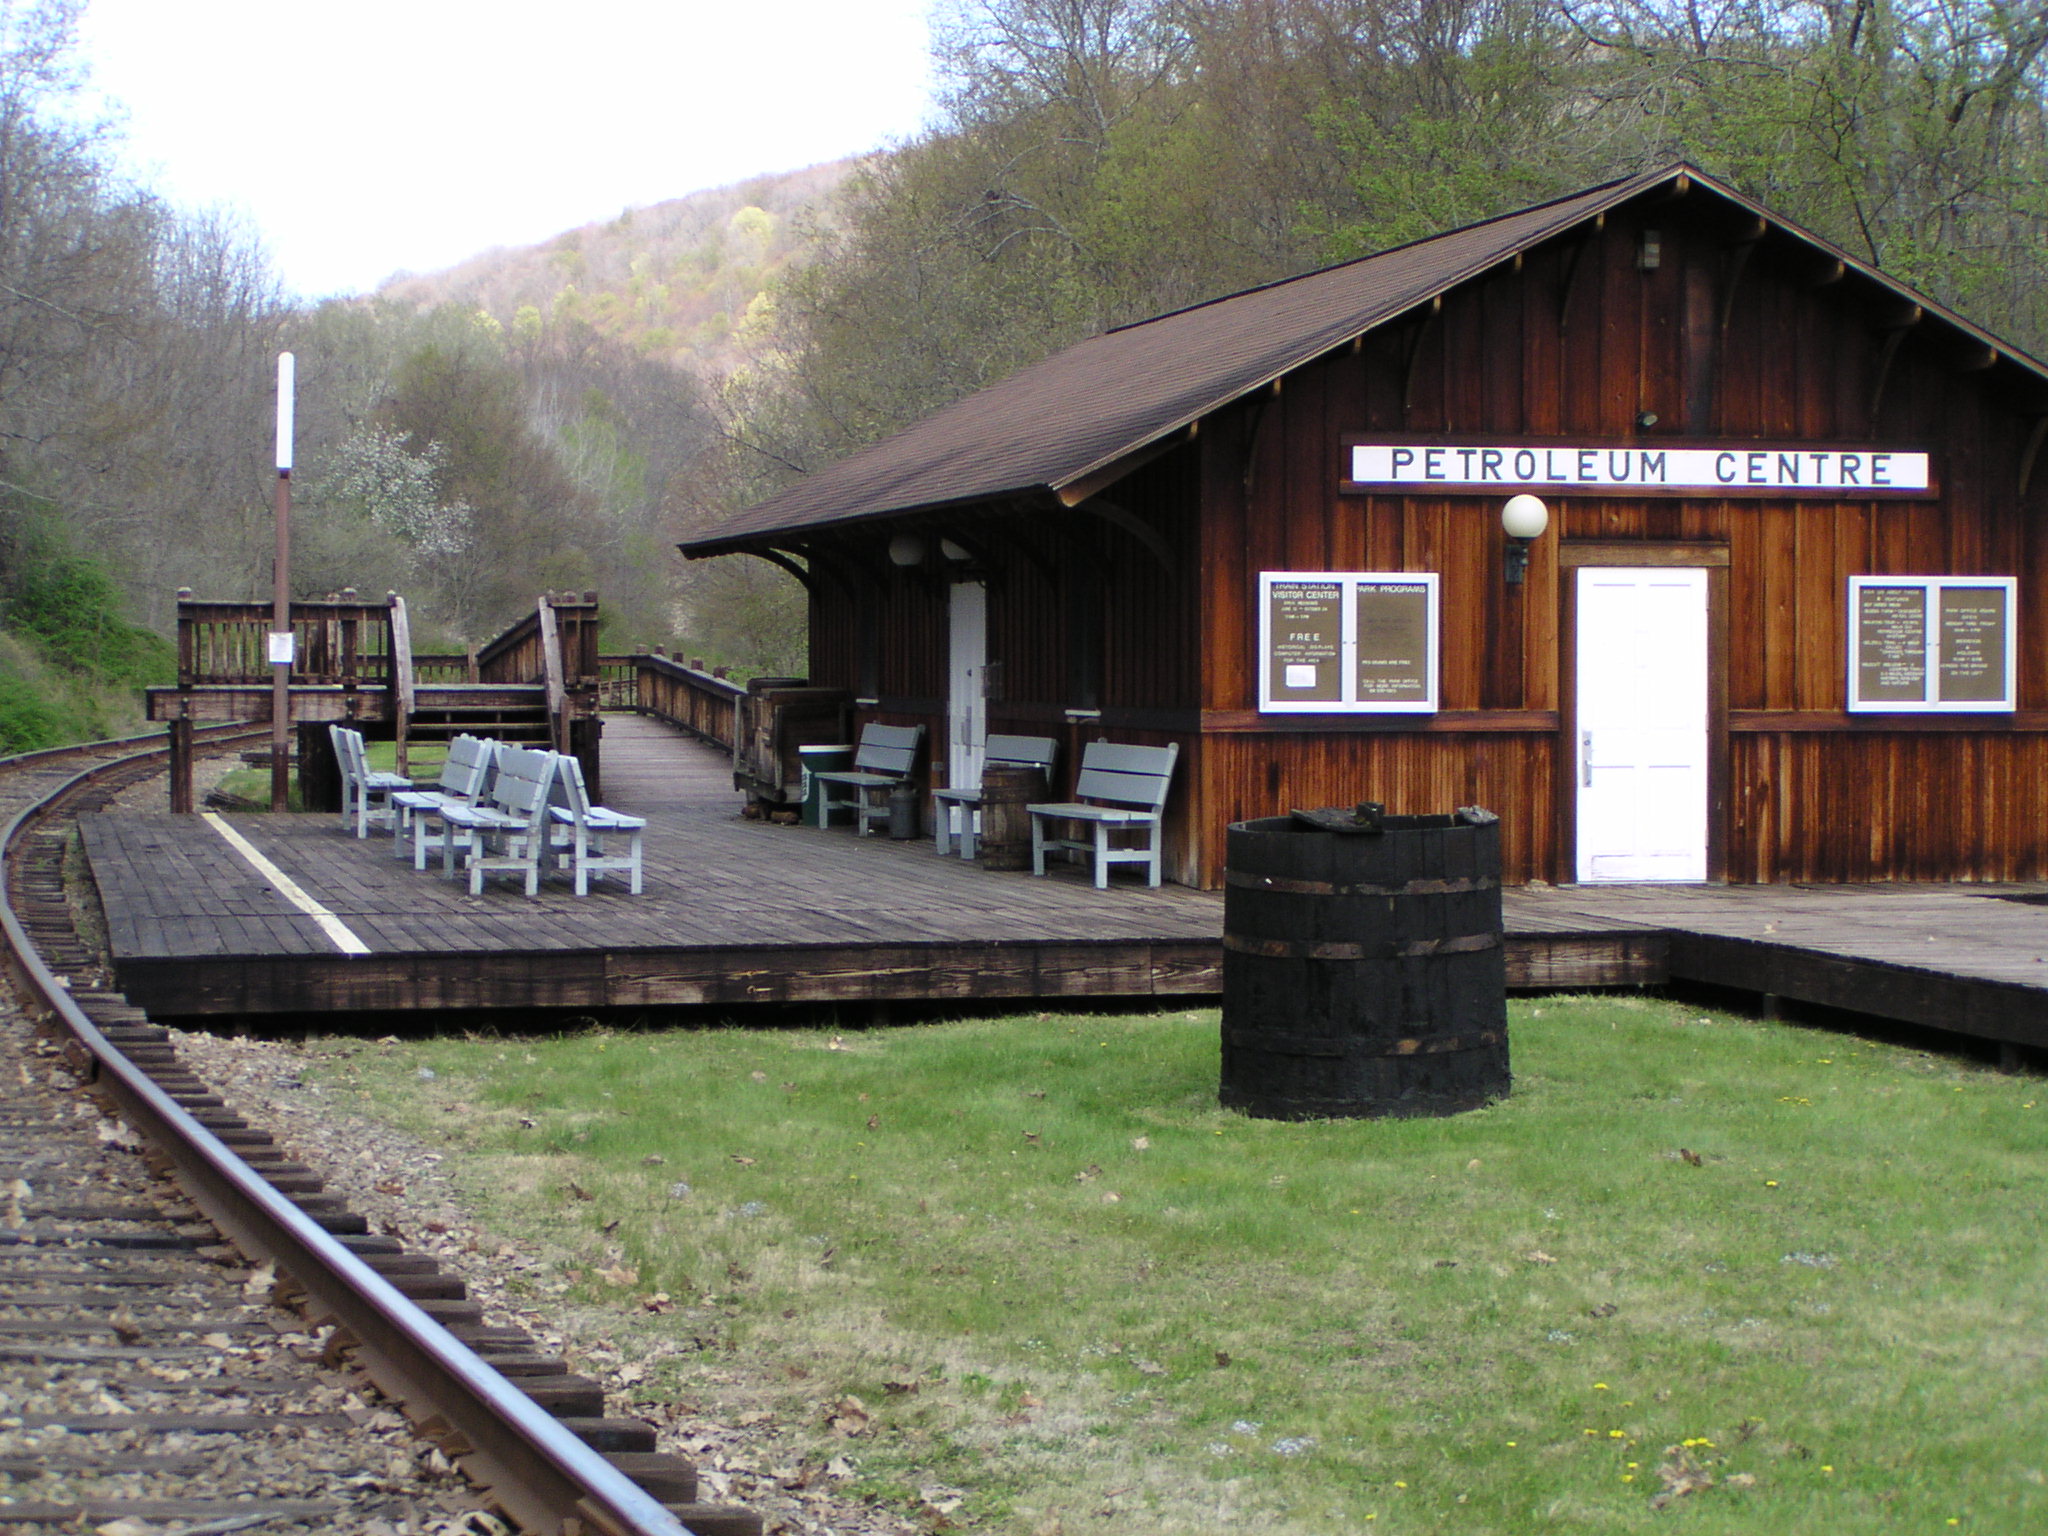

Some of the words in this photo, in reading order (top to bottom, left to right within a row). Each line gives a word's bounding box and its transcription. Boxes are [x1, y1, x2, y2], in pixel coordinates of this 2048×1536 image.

[1391, 448, 1667, 483] PETROLEUM
[1714, 453, 1893, 485] CENTRE
[1380, 585, 1426, 593] PROGRAMS
[1272, 590, 1304, 599] VISITOR
[1306, 590, 1340, 599] CENTER
[1289, 632, 1321, 641] FREE
